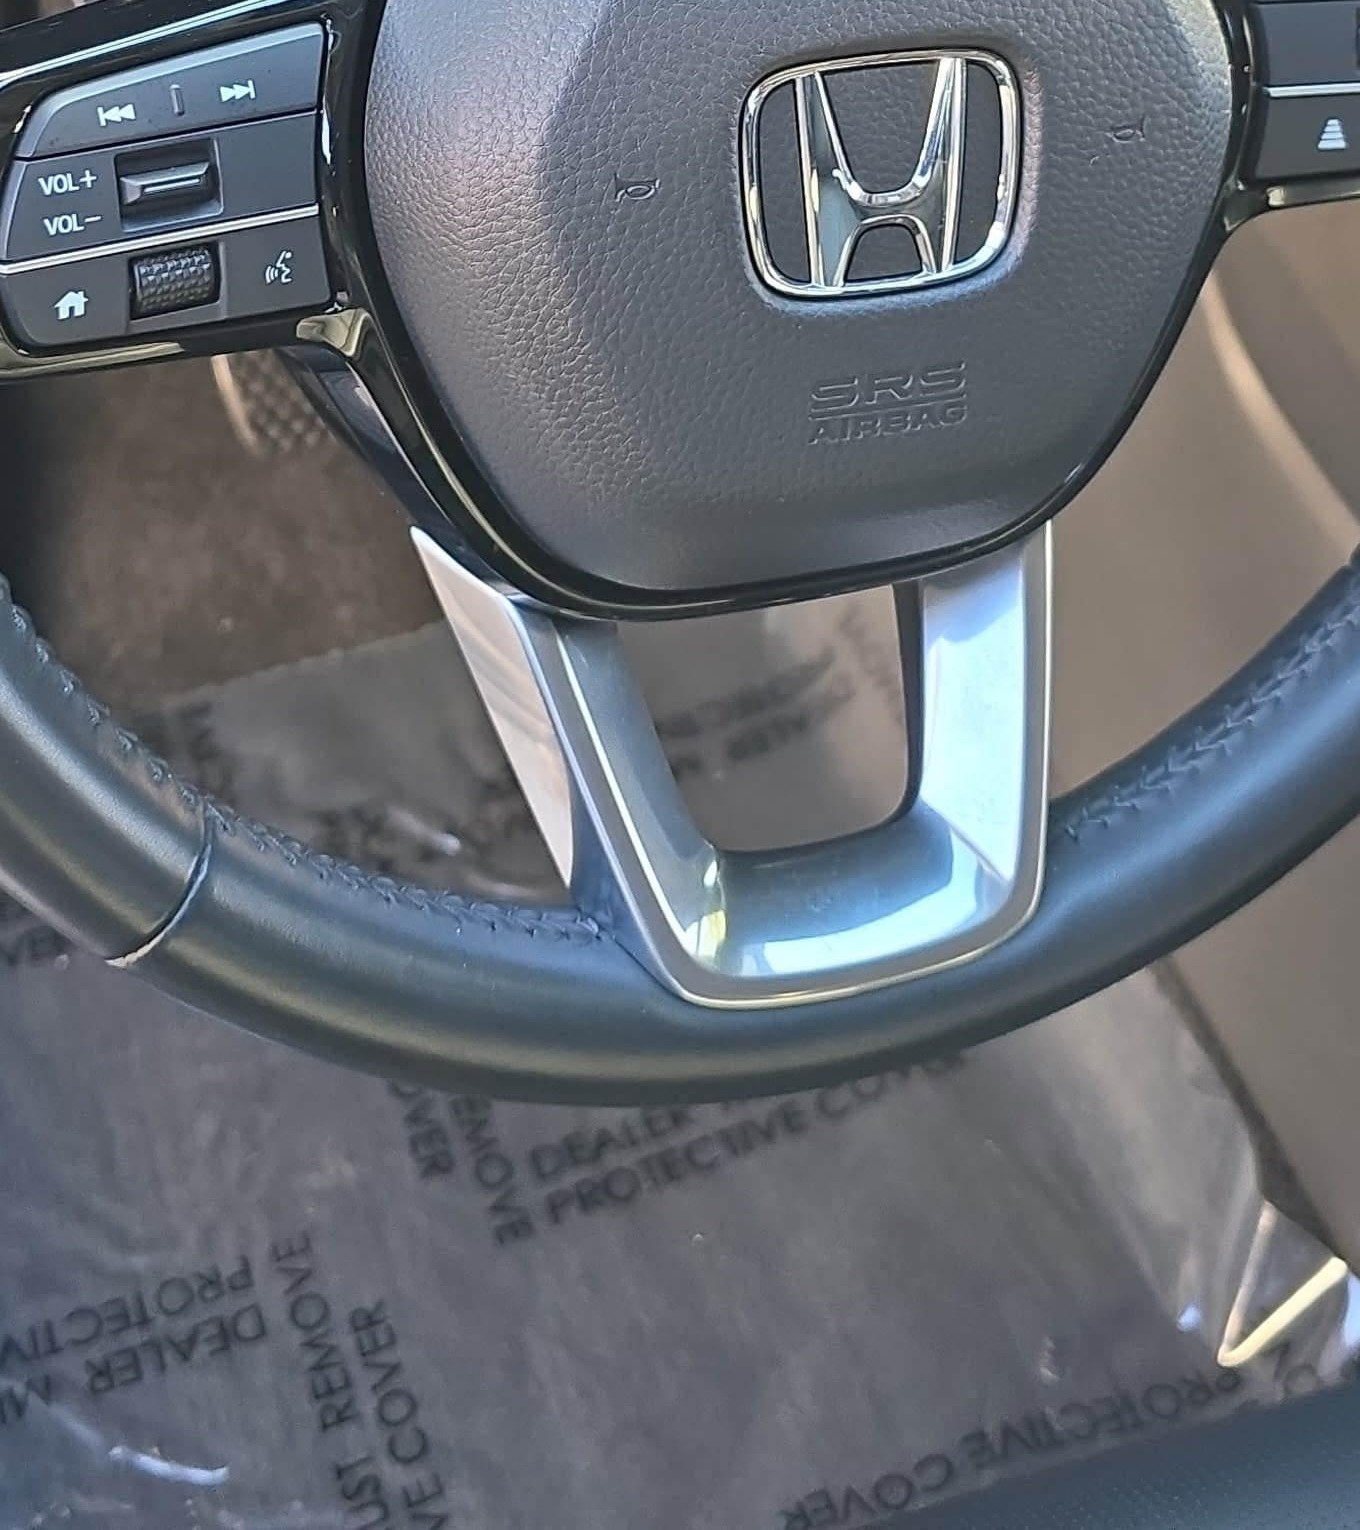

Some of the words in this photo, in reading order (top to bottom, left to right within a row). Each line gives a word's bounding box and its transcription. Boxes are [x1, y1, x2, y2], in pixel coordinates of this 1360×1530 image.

[38, 169, 98, 197] VOL+
[43, 214, 103, 238] VOL-
[807, 403, 968, 446] AIRBAG
[810, 361, 967, 413] SRS
[450, 1095, 537, 1248] EMOVE
[544, 1100, 812, 1224] PROTECTIVE
[82, 1303, 268, 1397] DEALER
[268, 1230, 357, 1434] REMOVE
[346, 1298, 428, 1466] COVER
